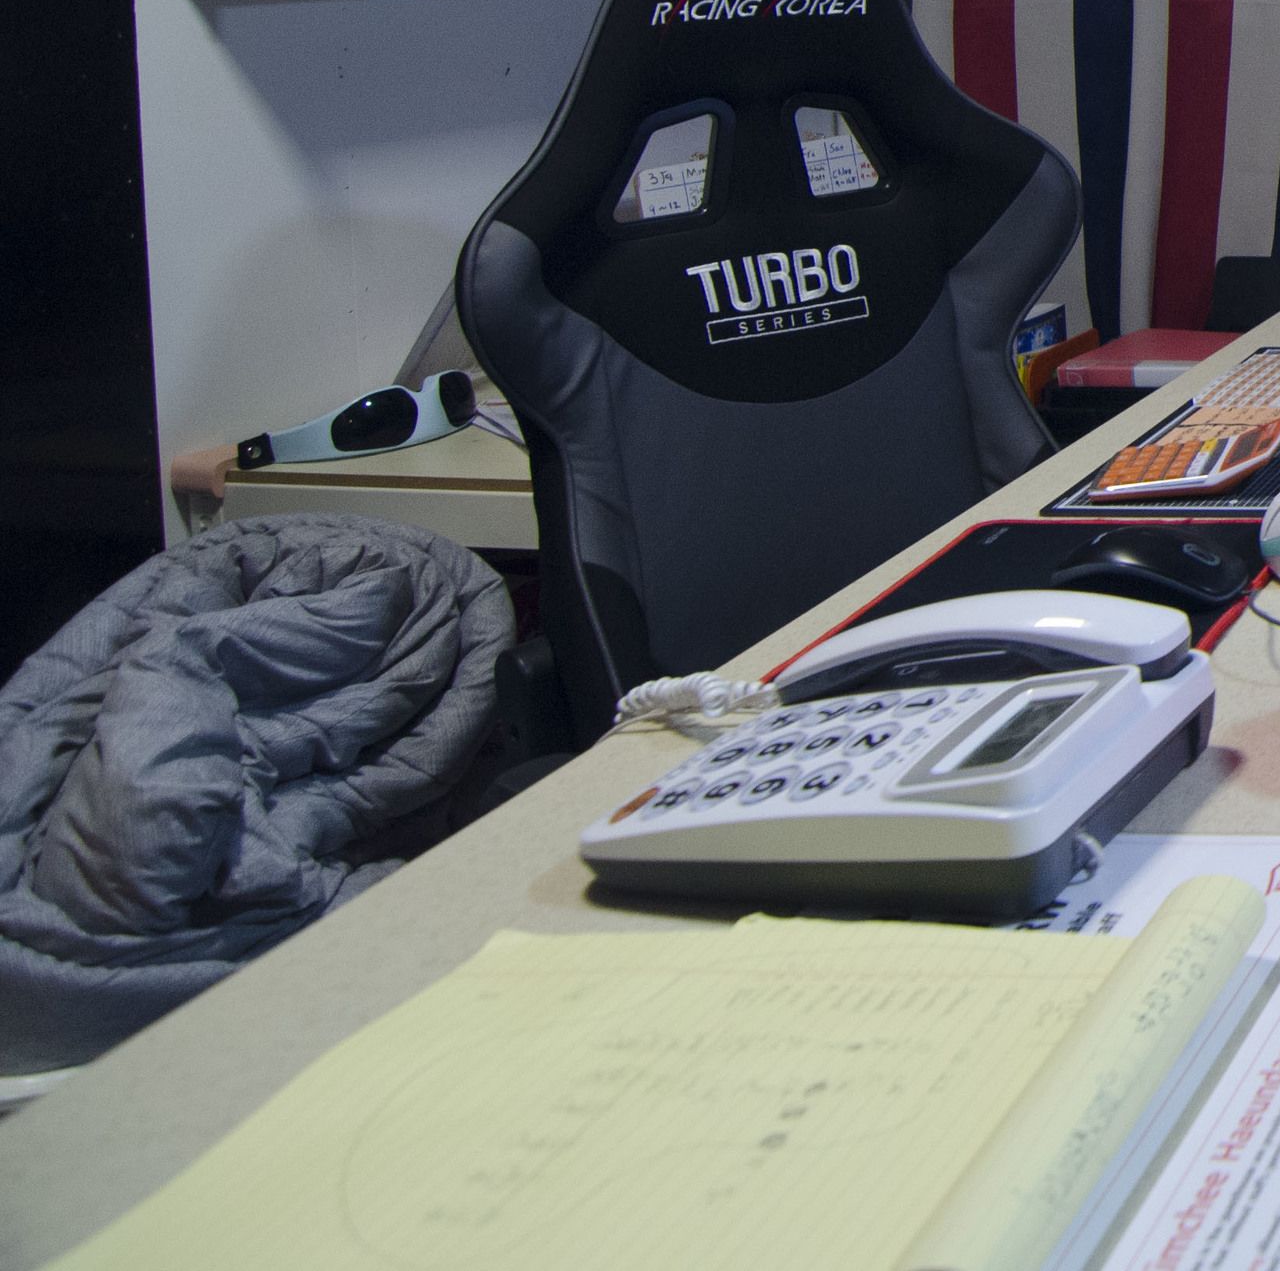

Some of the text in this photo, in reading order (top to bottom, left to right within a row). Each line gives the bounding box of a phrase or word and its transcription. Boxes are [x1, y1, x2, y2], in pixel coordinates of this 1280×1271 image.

[686, 244, 860, 313] TURBO
[738, 308, 832, 334] SERIES
[1144, 1172, 1230, 1271] imchee
